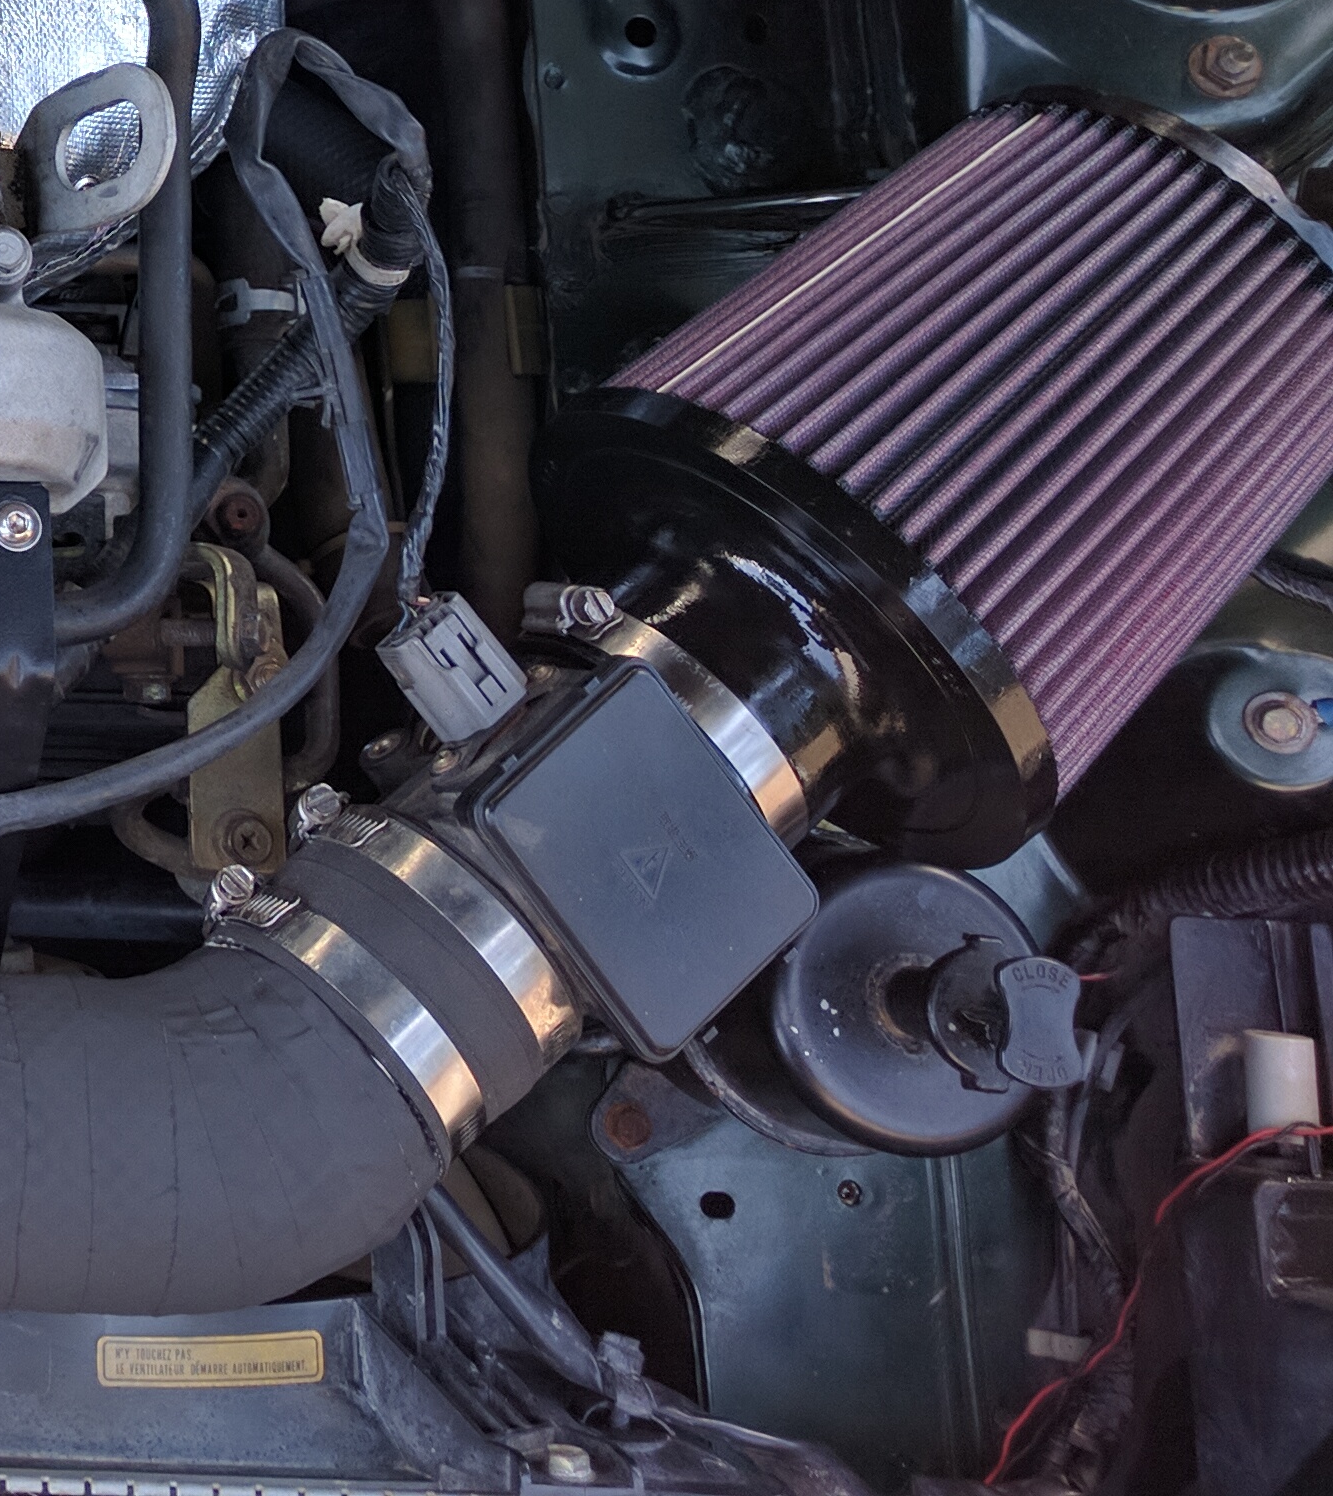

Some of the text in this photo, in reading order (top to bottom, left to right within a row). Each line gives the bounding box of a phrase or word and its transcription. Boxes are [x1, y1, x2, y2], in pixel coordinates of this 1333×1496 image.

[1012, 963, 1071, 988] CLOSE
[136, 1346, 171, 1361] TOUCHEZ
[115, 1363, 124, 1374] LE
[130, 1362, 184, 1376] VENTILATEUR
[189, 1359, 228, 1375] DÉMARRE
